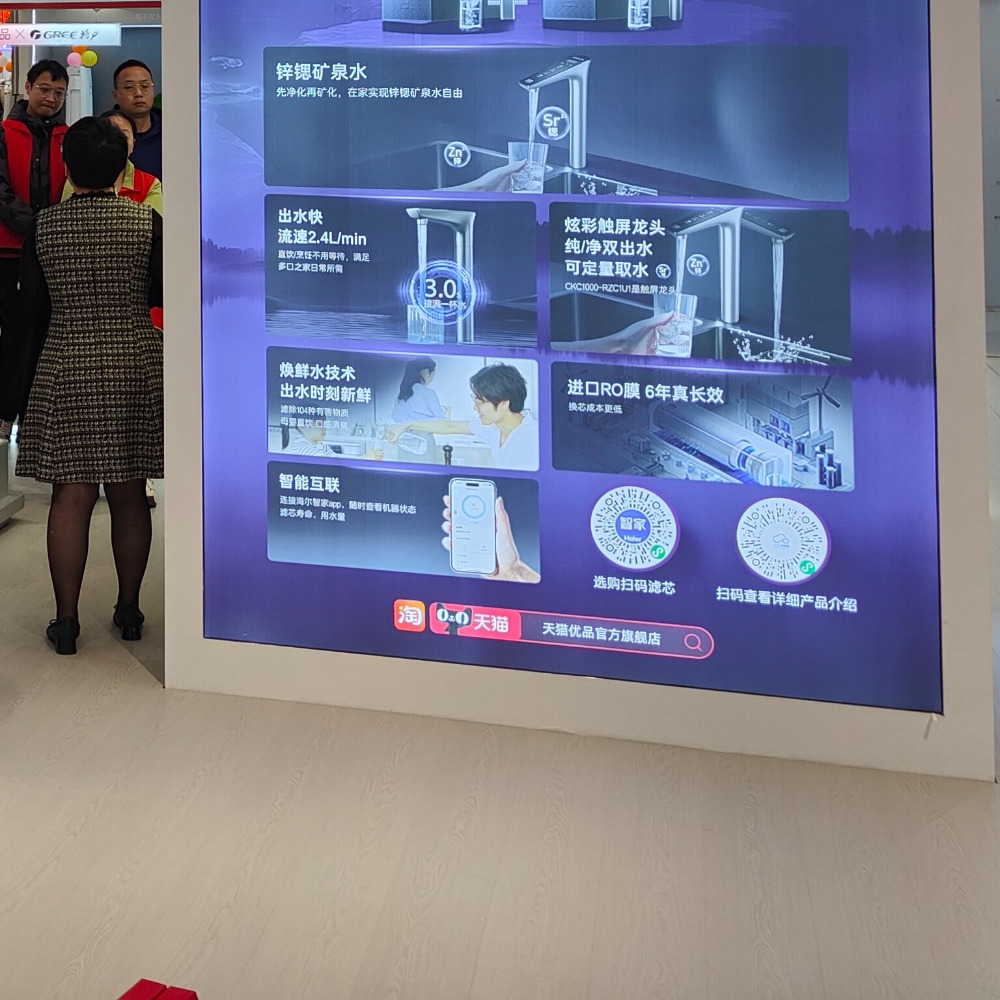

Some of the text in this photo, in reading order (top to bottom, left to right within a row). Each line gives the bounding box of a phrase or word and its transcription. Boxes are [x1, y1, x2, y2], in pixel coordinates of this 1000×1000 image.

[43, 30, 78, 39] GREE
[275, 62, 368, 82] 锌锶矿泉水
[278, 208, 323, 225] 出水快
[564, 216, 666, 236] 炫彩触屏龙头
[278, 228, 367, 246] 流速2.4L/min
[565, 260, 649, 278] 可定量取水
[279, 361, 356, 382] 焕鲜水技术
[280, 383, 372, 404] 出水时刻新鲜
[567, 379, 725, 405] 进口RO膜 6年真长效
[568, 401, 623, 414] 换芯成本更低
[278, 472, 340, 493] 智能互联
[593, 575, 676, 595] 选购扫码滤芯
[716, 586, 858, 613] 扫码查看详细产品介绍
[397, 604, 662, 646] 淘 天猫 天猫优品官方旗舰店
